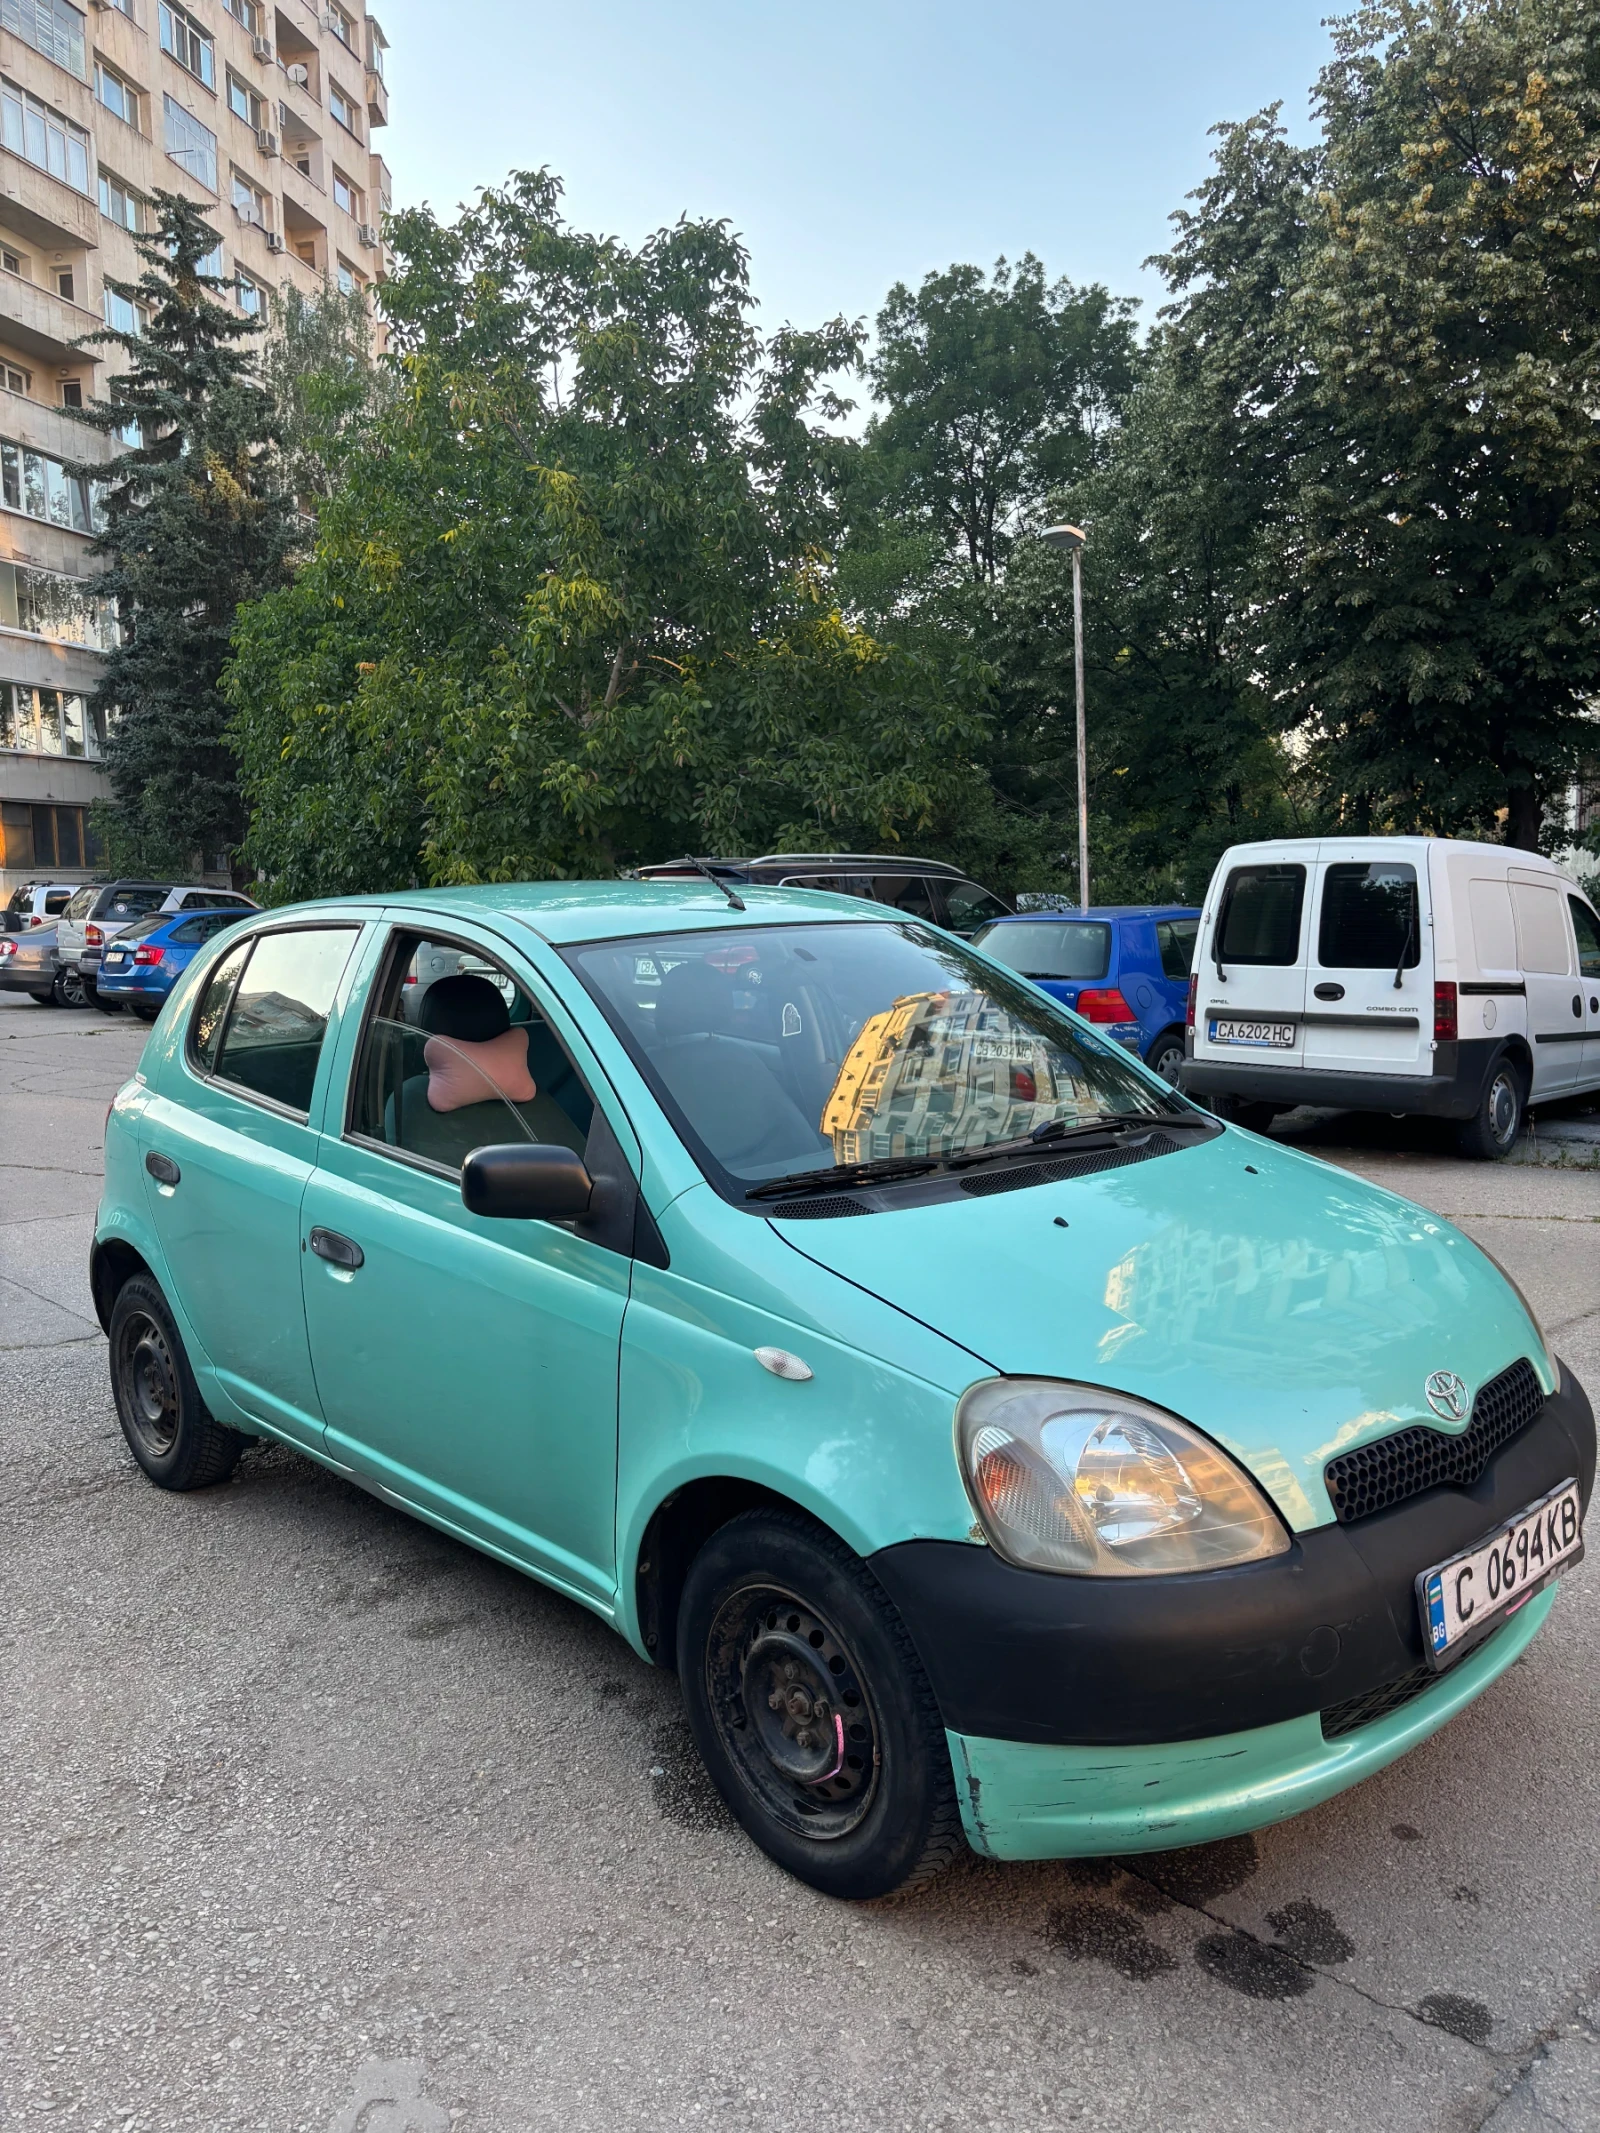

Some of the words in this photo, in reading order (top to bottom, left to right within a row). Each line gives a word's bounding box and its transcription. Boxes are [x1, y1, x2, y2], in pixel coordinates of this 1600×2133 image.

[1218, 1022, 1236, 1038] CA
[1237, 1023, 1271, 1041] 6202
[1272, 1025, 1292, 1042] HC
[1456, 1566, 1475, 1623] C
[1488, 1515, 1544, 1600] 0694
[1547, 1496, 1577, 1559] KB
[1432, 1621, 1446, 1643] BG
